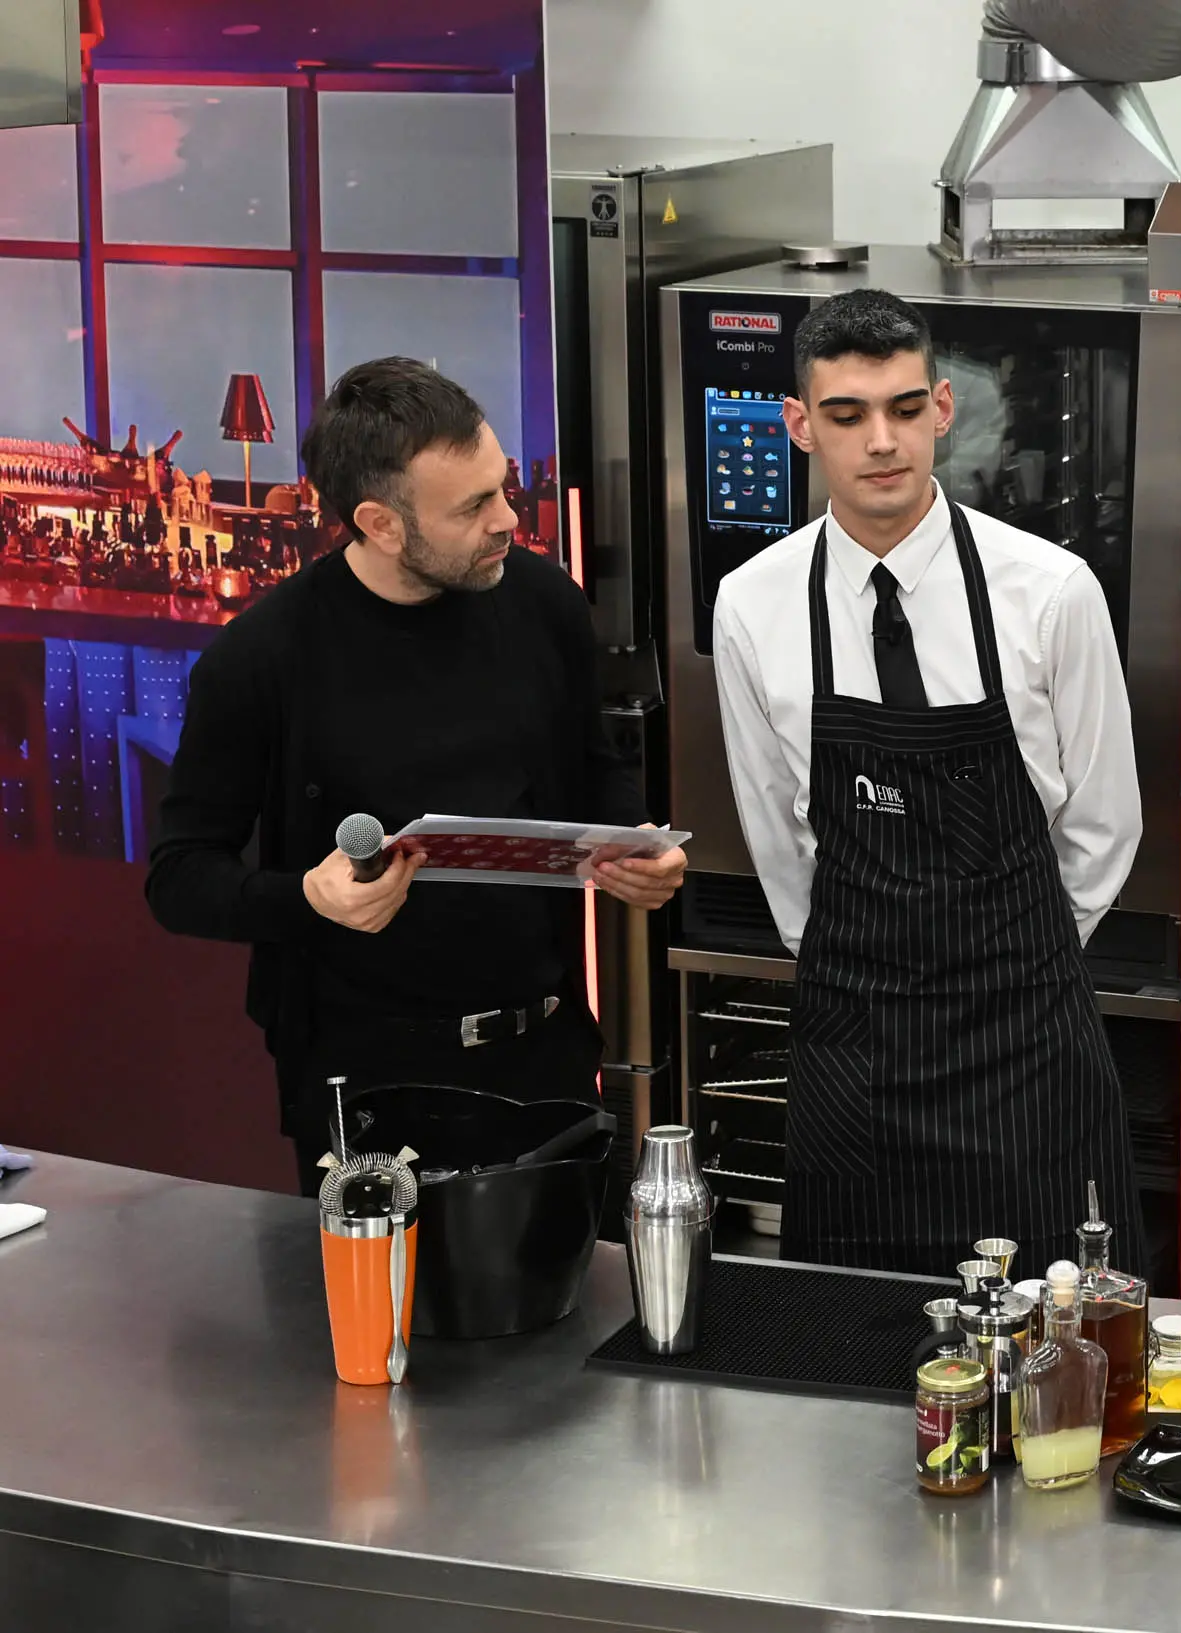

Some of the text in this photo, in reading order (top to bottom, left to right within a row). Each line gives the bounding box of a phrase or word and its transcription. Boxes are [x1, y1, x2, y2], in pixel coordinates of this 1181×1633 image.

[713, 315, 777, 329] RATIONAL
[716, 339, 776, 353] iCombi Pro
[875, 784, 904, 804] ENAC
[875, 805, 906, 816] CANOSSA
